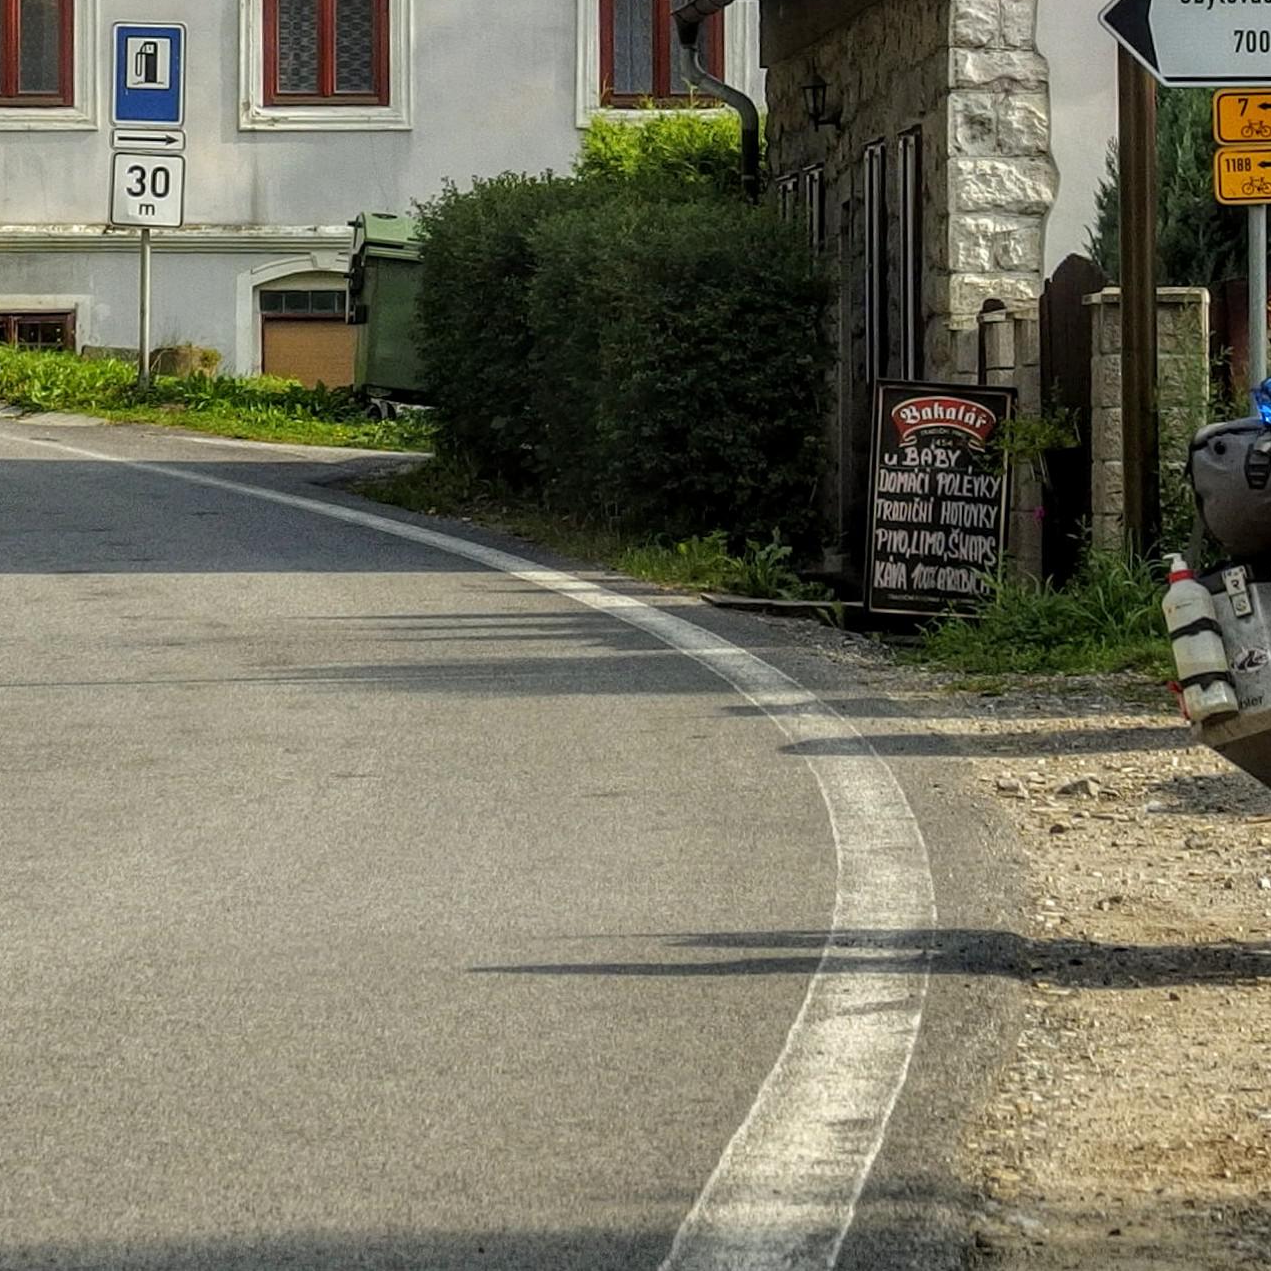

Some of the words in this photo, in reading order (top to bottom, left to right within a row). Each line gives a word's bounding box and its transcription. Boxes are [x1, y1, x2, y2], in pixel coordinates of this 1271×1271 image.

[1234, 30, 1270, 53] 700
[1237, 98, 1249, 117] 7
[1225, 157, 1252, 173] 1188
[126, 165, 170, 198] 30
[139, 203, 155, 216] m
[900, 401, 987, 428] Bakalář
